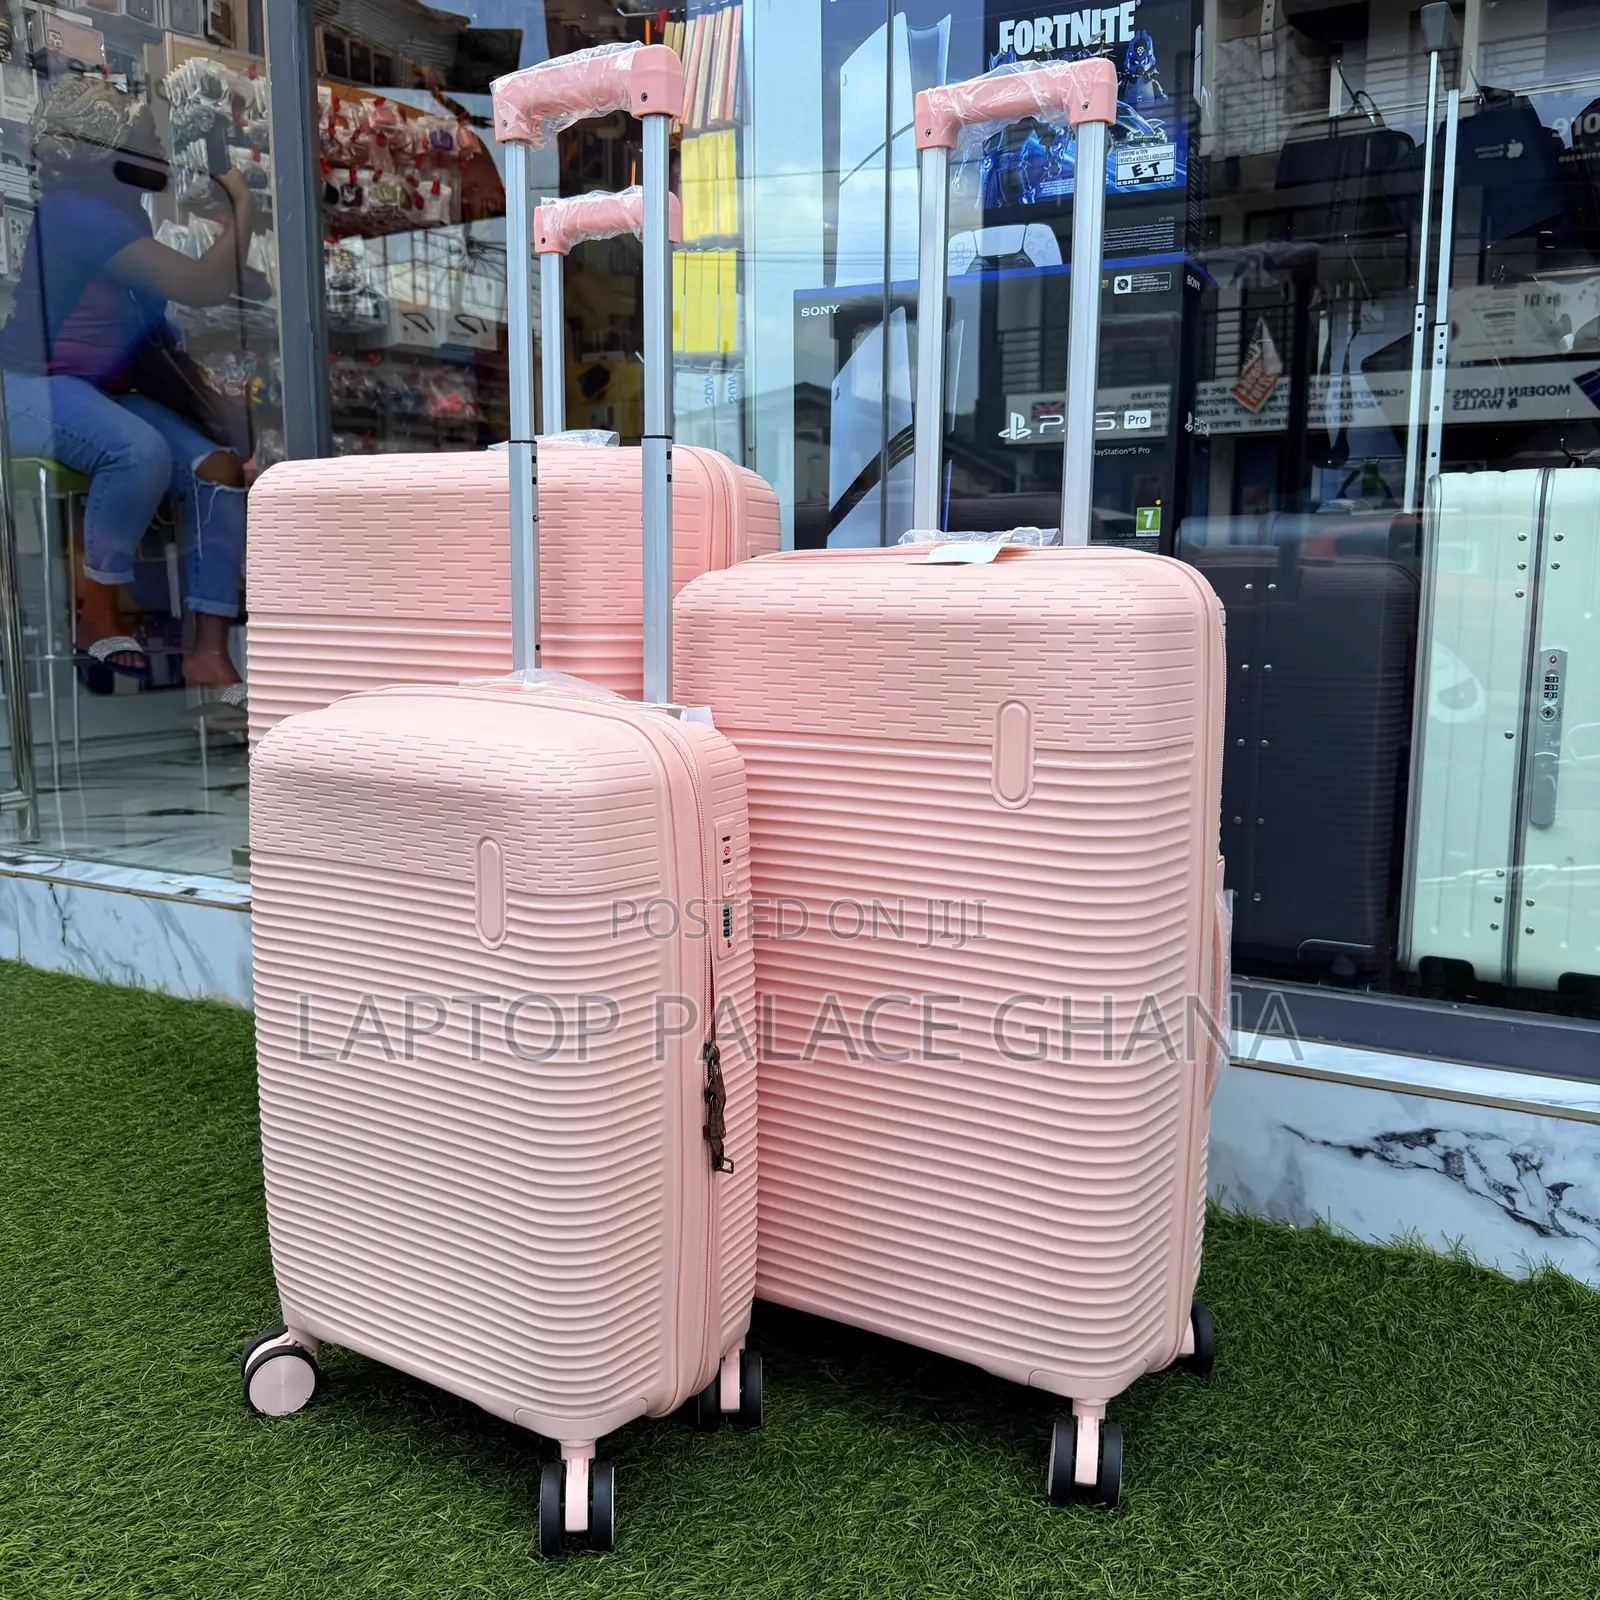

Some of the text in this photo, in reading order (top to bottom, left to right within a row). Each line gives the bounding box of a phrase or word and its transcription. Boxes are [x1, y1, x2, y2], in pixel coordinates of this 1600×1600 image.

[999, 0, 1136, 56] FORTNITE
[1131, 161, 1160, 177] E-T
[1186, 274, 1201, 291] SONY
[801, 304, 840, 317] SONY
[704, 373, 715, 405] 20W
[728, 373, 738, 405] 20W
[1127, 414, 1147, 426] Pro
[1138, 446, 1151, 454] Pro
[1143, 510, 1154, 529] 7
